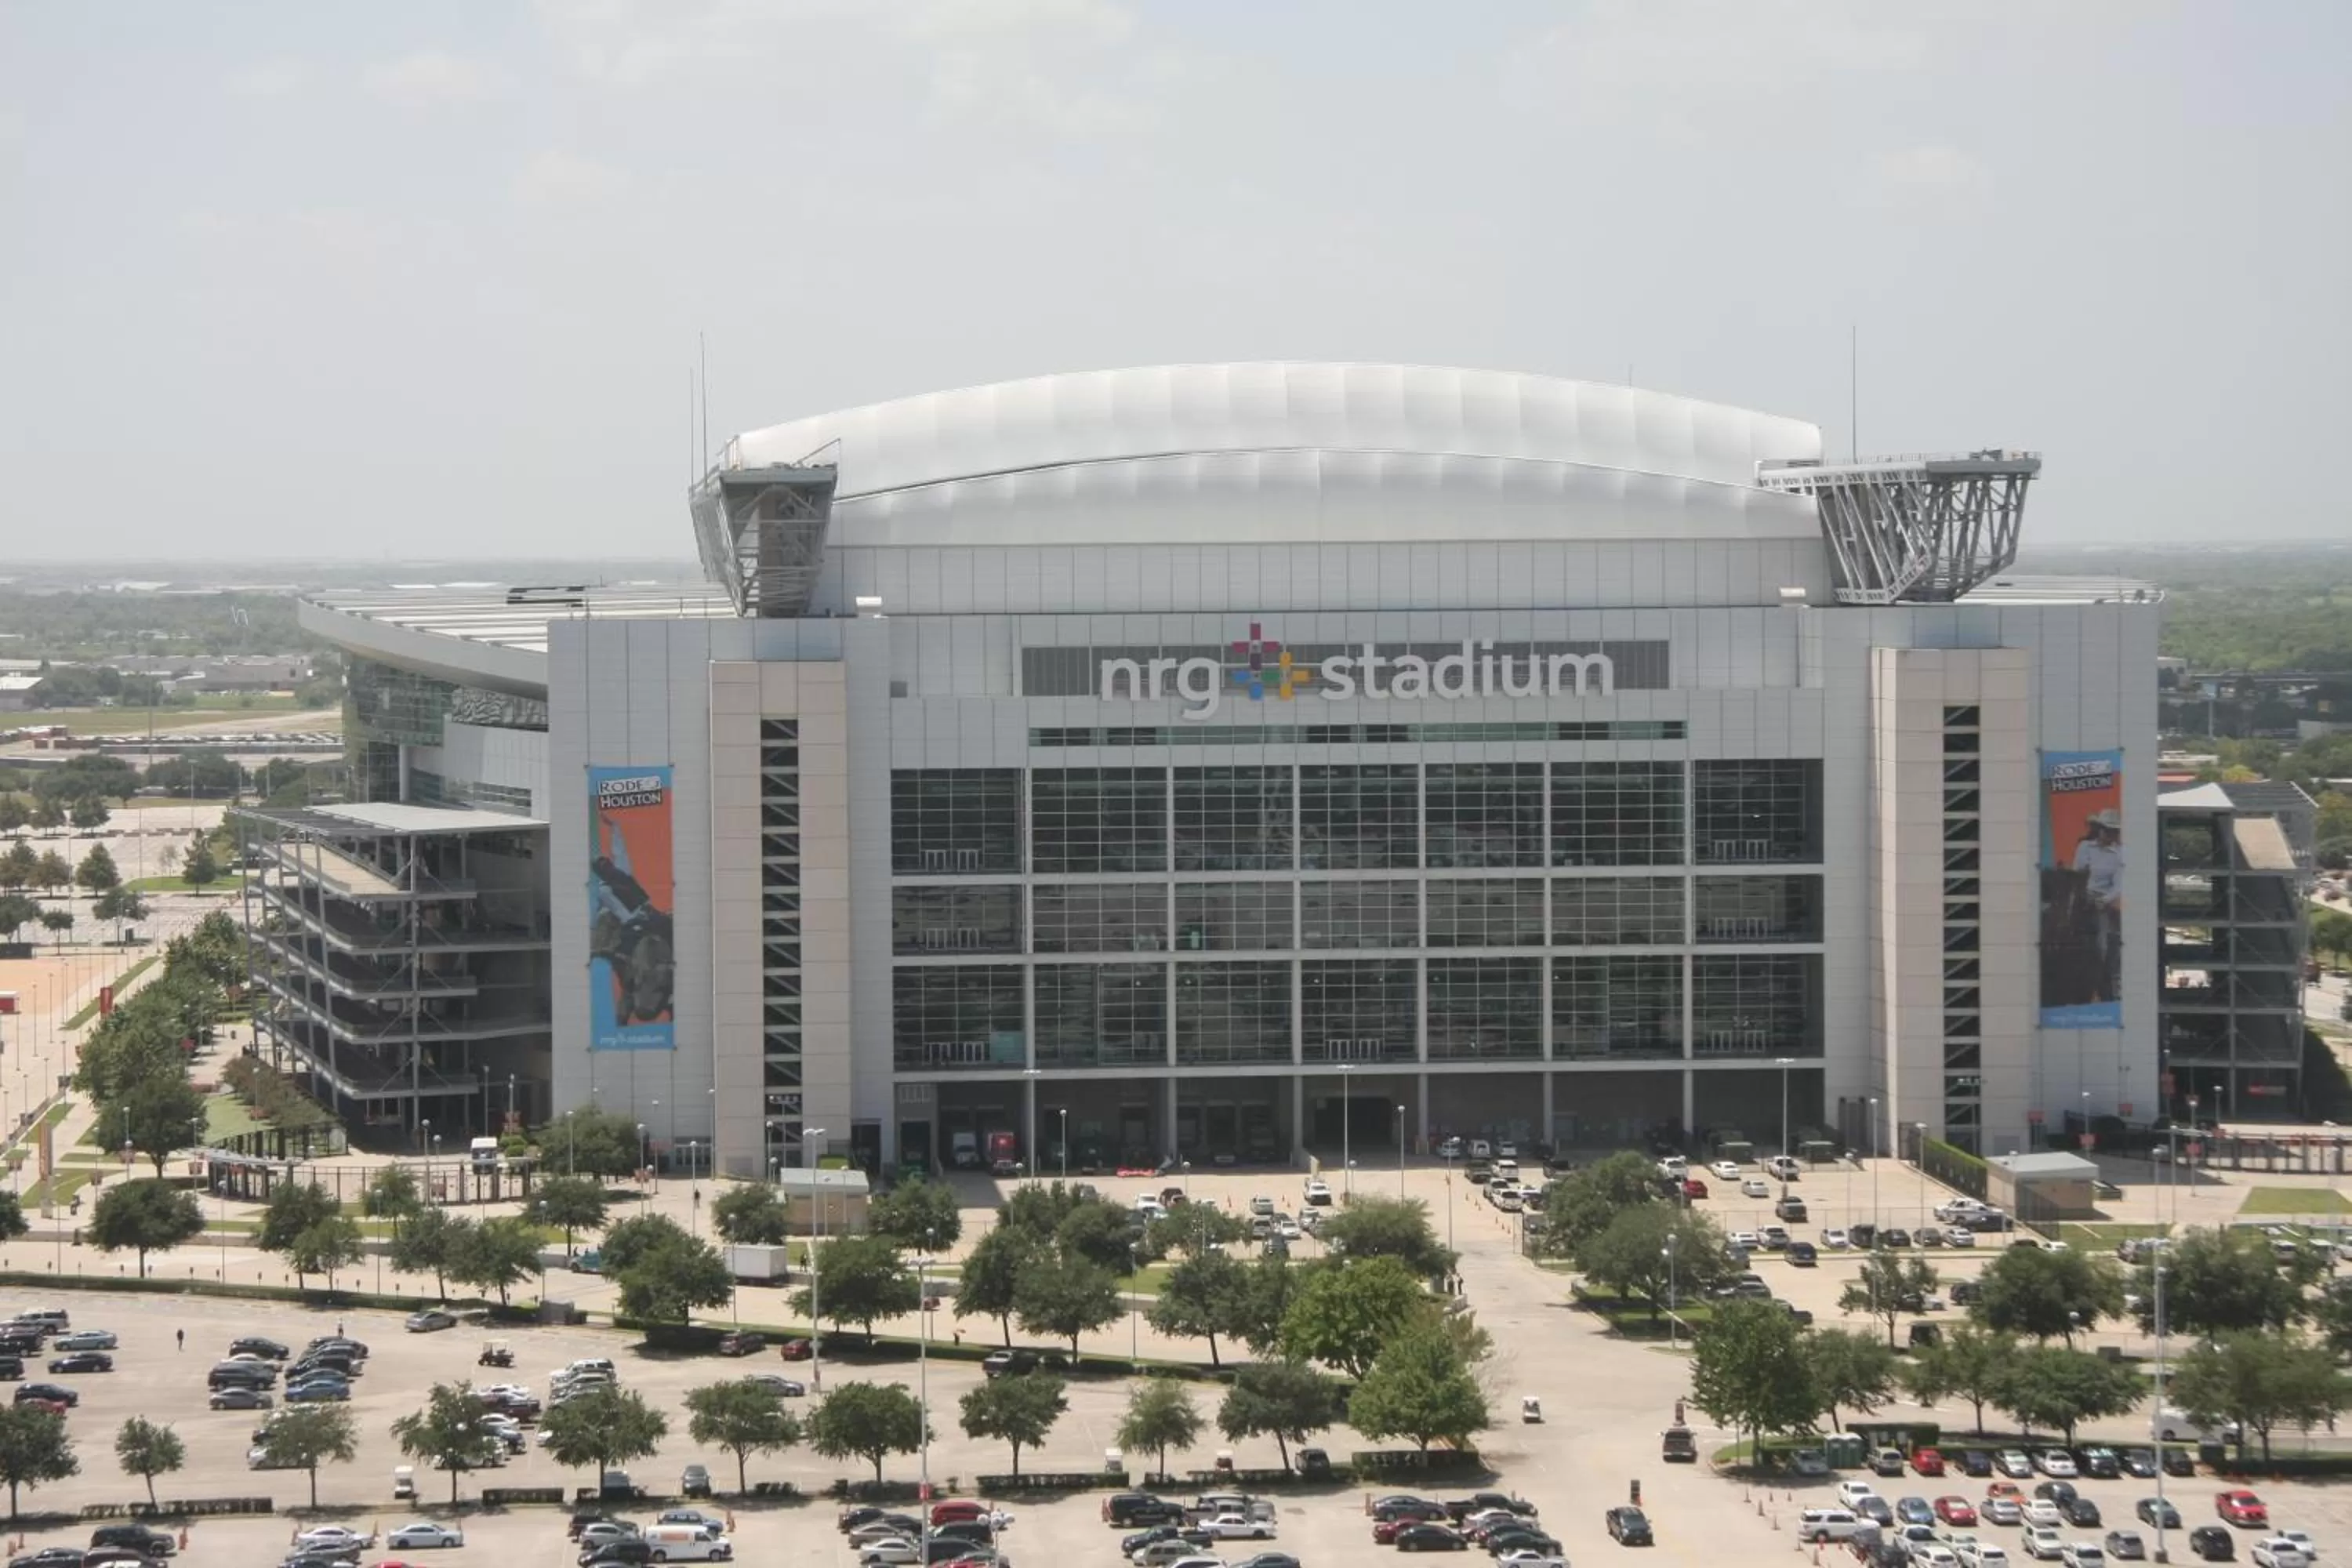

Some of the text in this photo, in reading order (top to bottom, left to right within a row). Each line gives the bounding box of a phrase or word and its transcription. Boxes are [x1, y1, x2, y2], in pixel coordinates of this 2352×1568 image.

[1101, 638, 1613, 720] nrg stadium
[2052, 761, 2111, 776] RODE
[601, 793, 661, 808] HOUSTON
